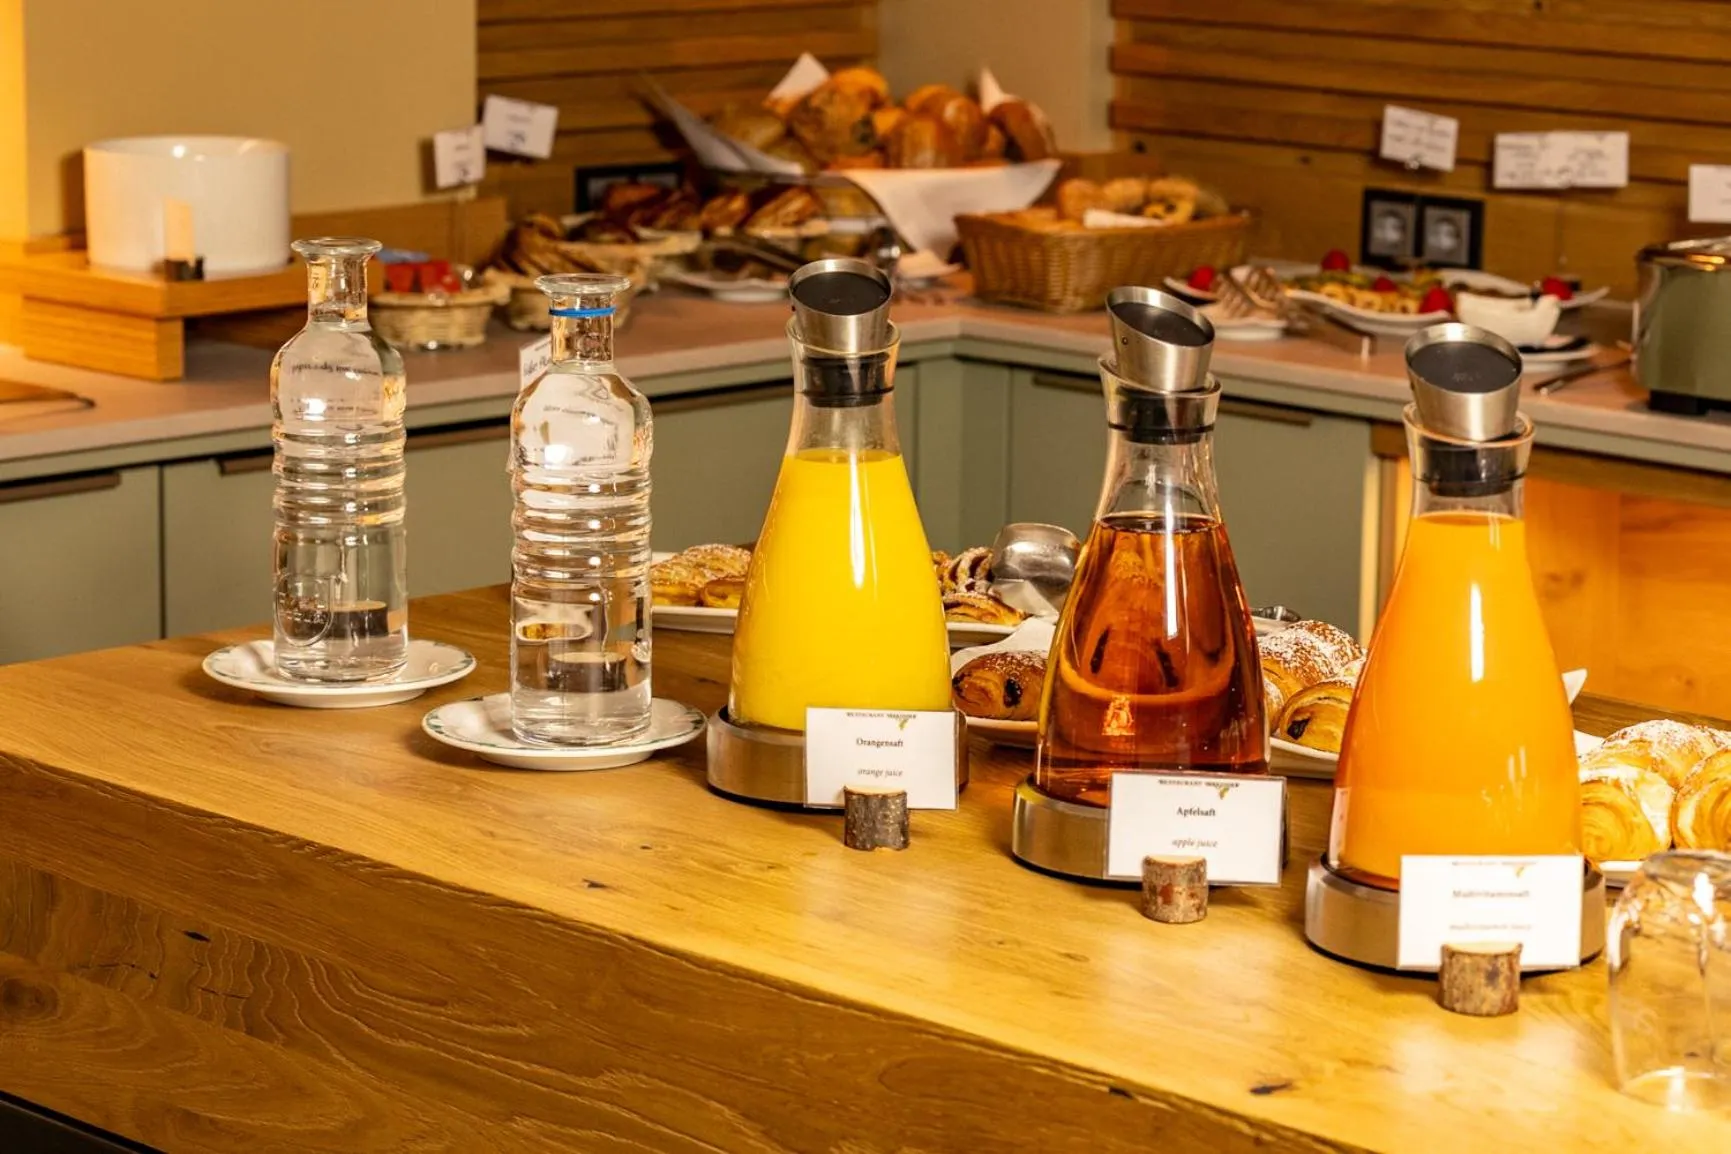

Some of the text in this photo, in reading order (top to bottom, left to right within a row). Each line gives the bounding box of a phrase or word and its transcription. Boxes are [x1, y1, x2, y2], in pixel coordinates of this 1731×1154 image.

[856, 737, 904, 748] Orangensaft
[858, 768, 903, 778] orange juice
[1176, 806, 1216, 818] Apfelsaft
[1171, 837, 1218, 849] apple juice
